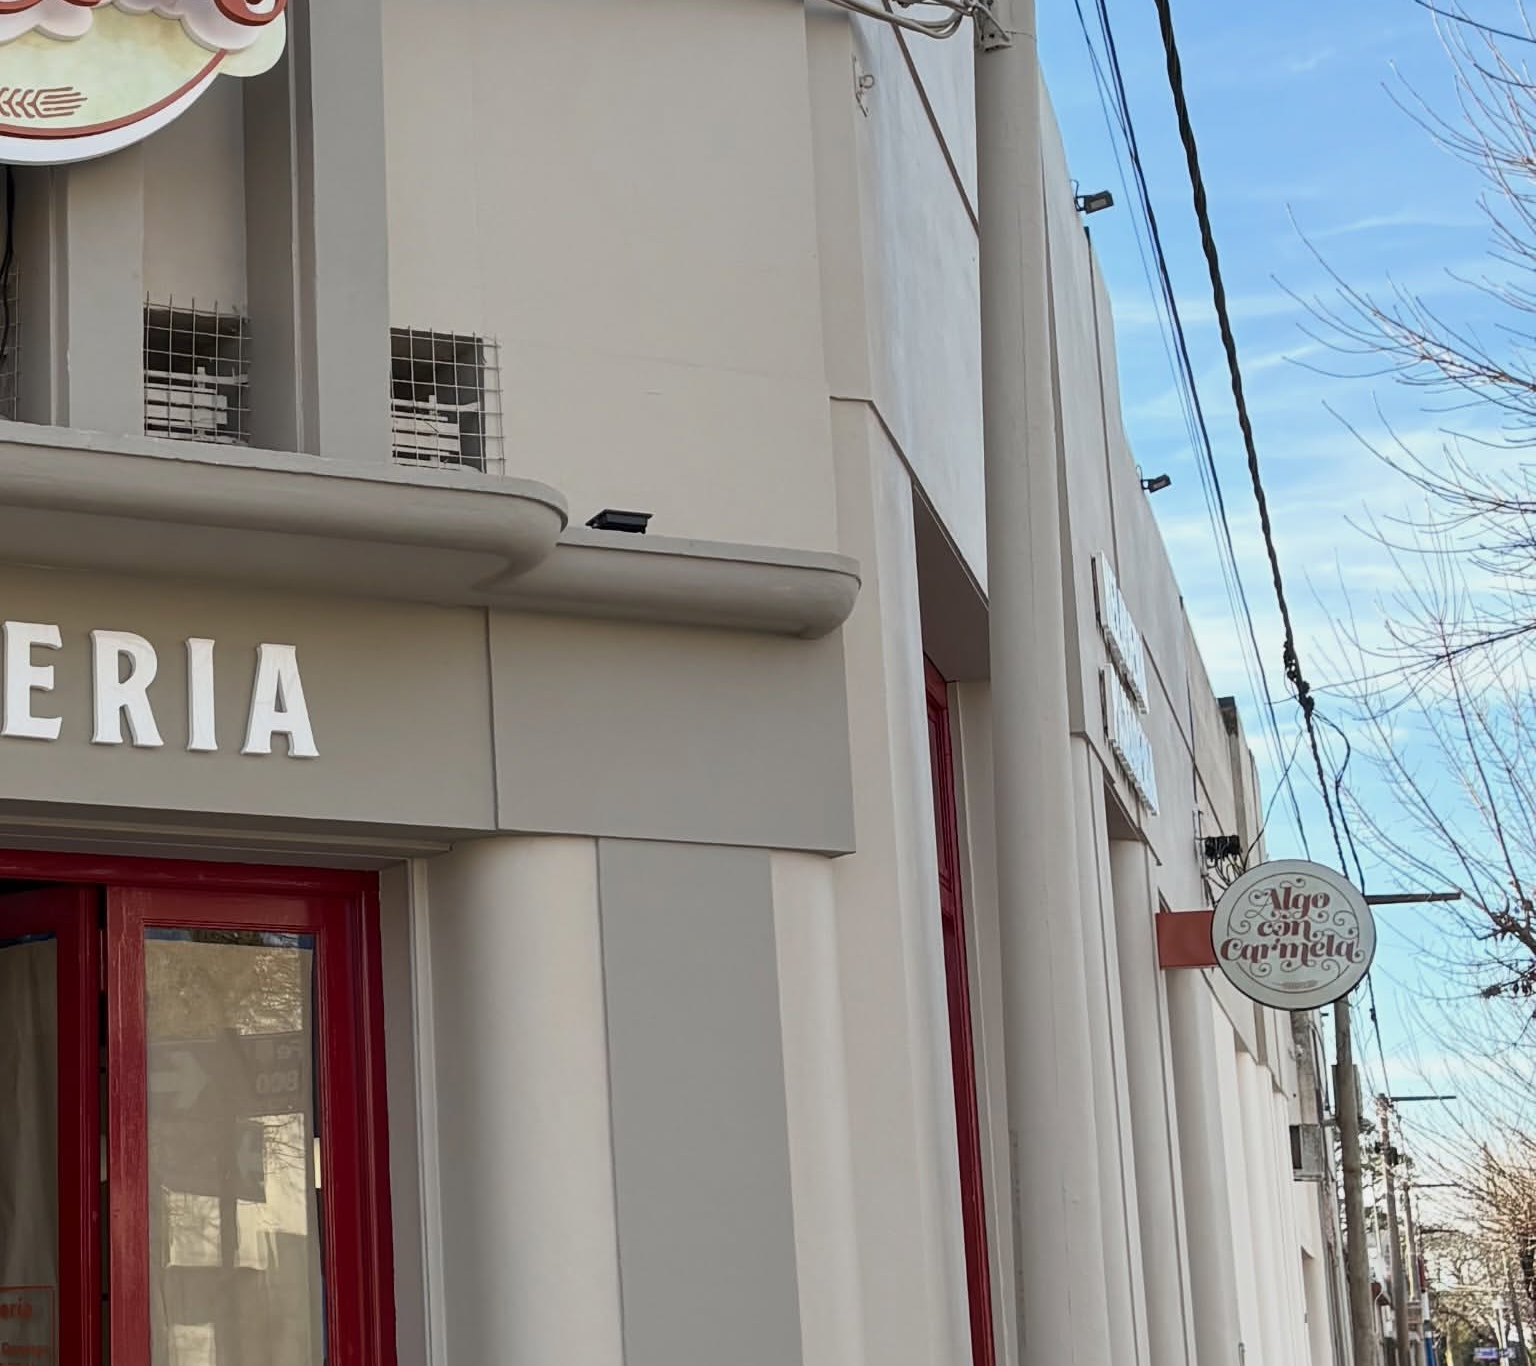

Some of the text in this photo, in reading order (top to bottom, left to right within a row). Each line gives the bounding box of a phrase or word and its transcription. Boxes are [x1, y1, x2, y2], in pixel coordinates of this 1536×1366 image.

[1245, 878, 1331, 922] Algo
[1257, 918, 1320, 942] con
[1220, 929, 1364, 977] Carmela
